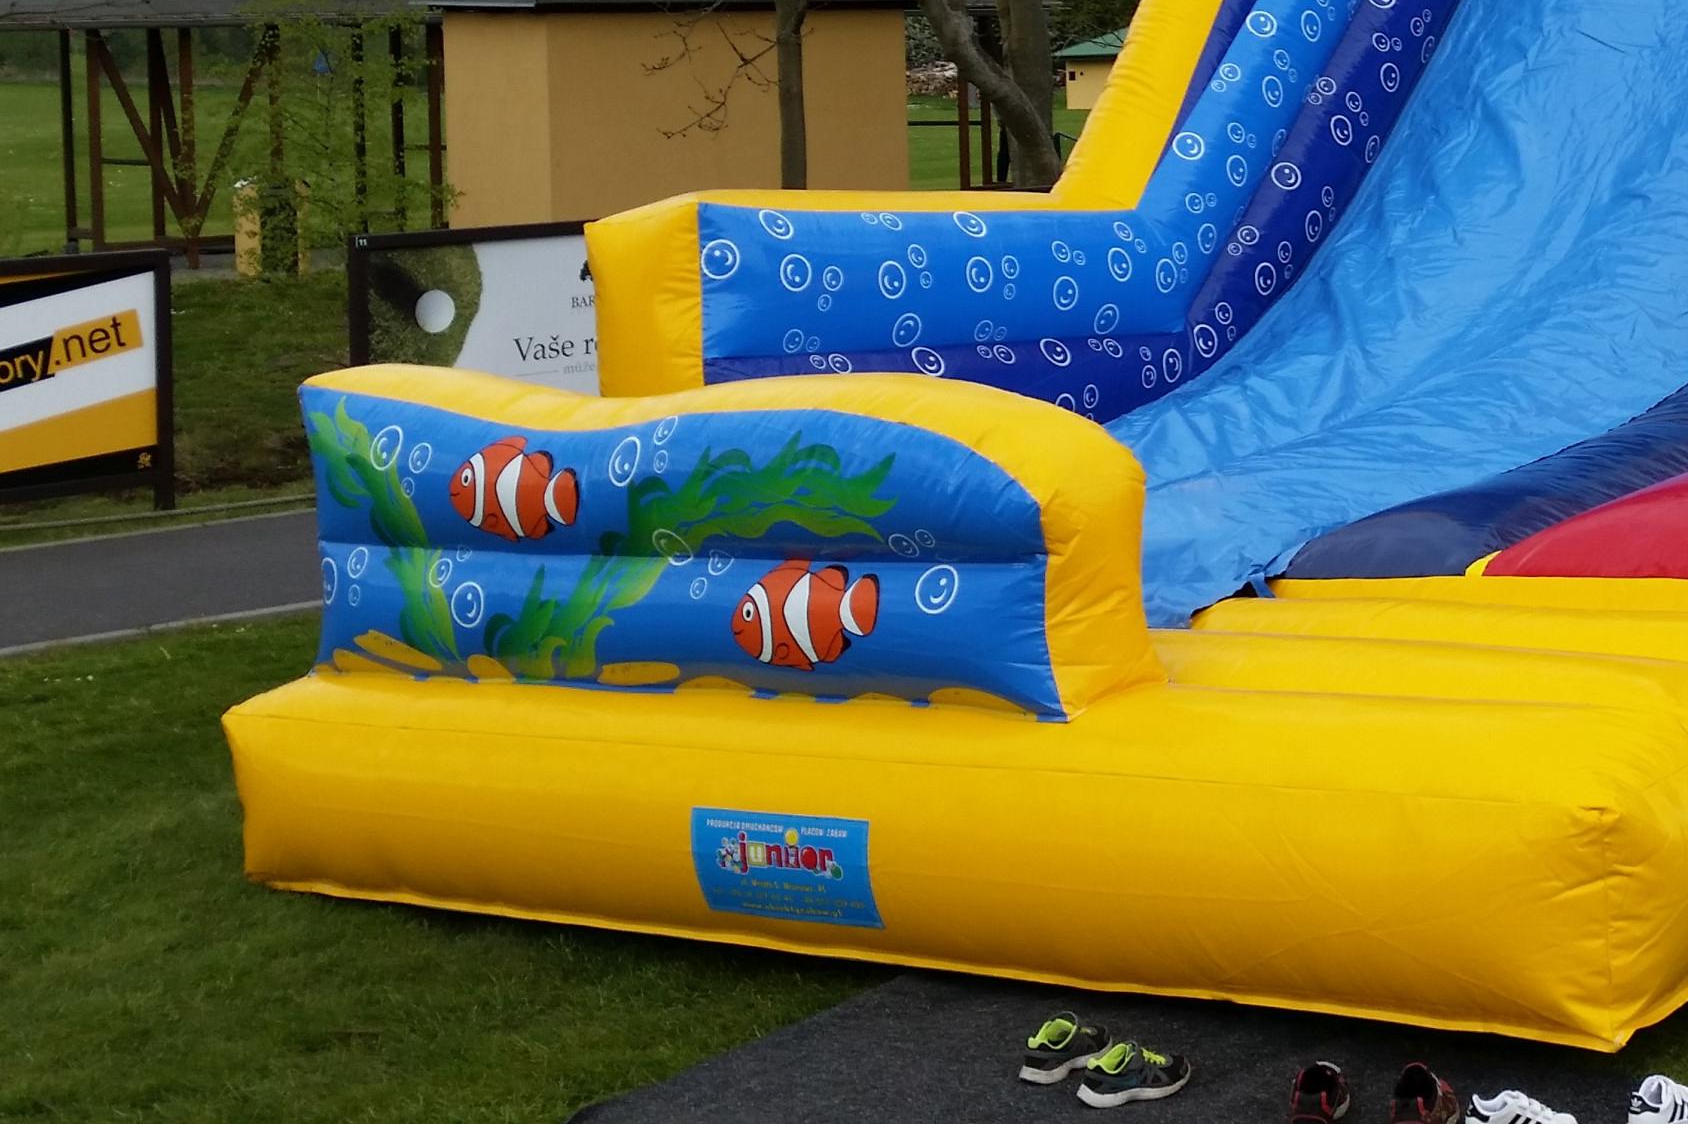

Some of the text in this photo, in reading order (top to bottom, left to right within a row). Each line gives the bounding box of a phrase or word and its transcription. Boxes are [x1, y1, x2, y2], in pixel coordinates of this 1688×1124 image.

[0, 316, 126, 384] ory.net
[513, 335, 598, 361] Vaše r
[738, 829, 833, 874] junior
